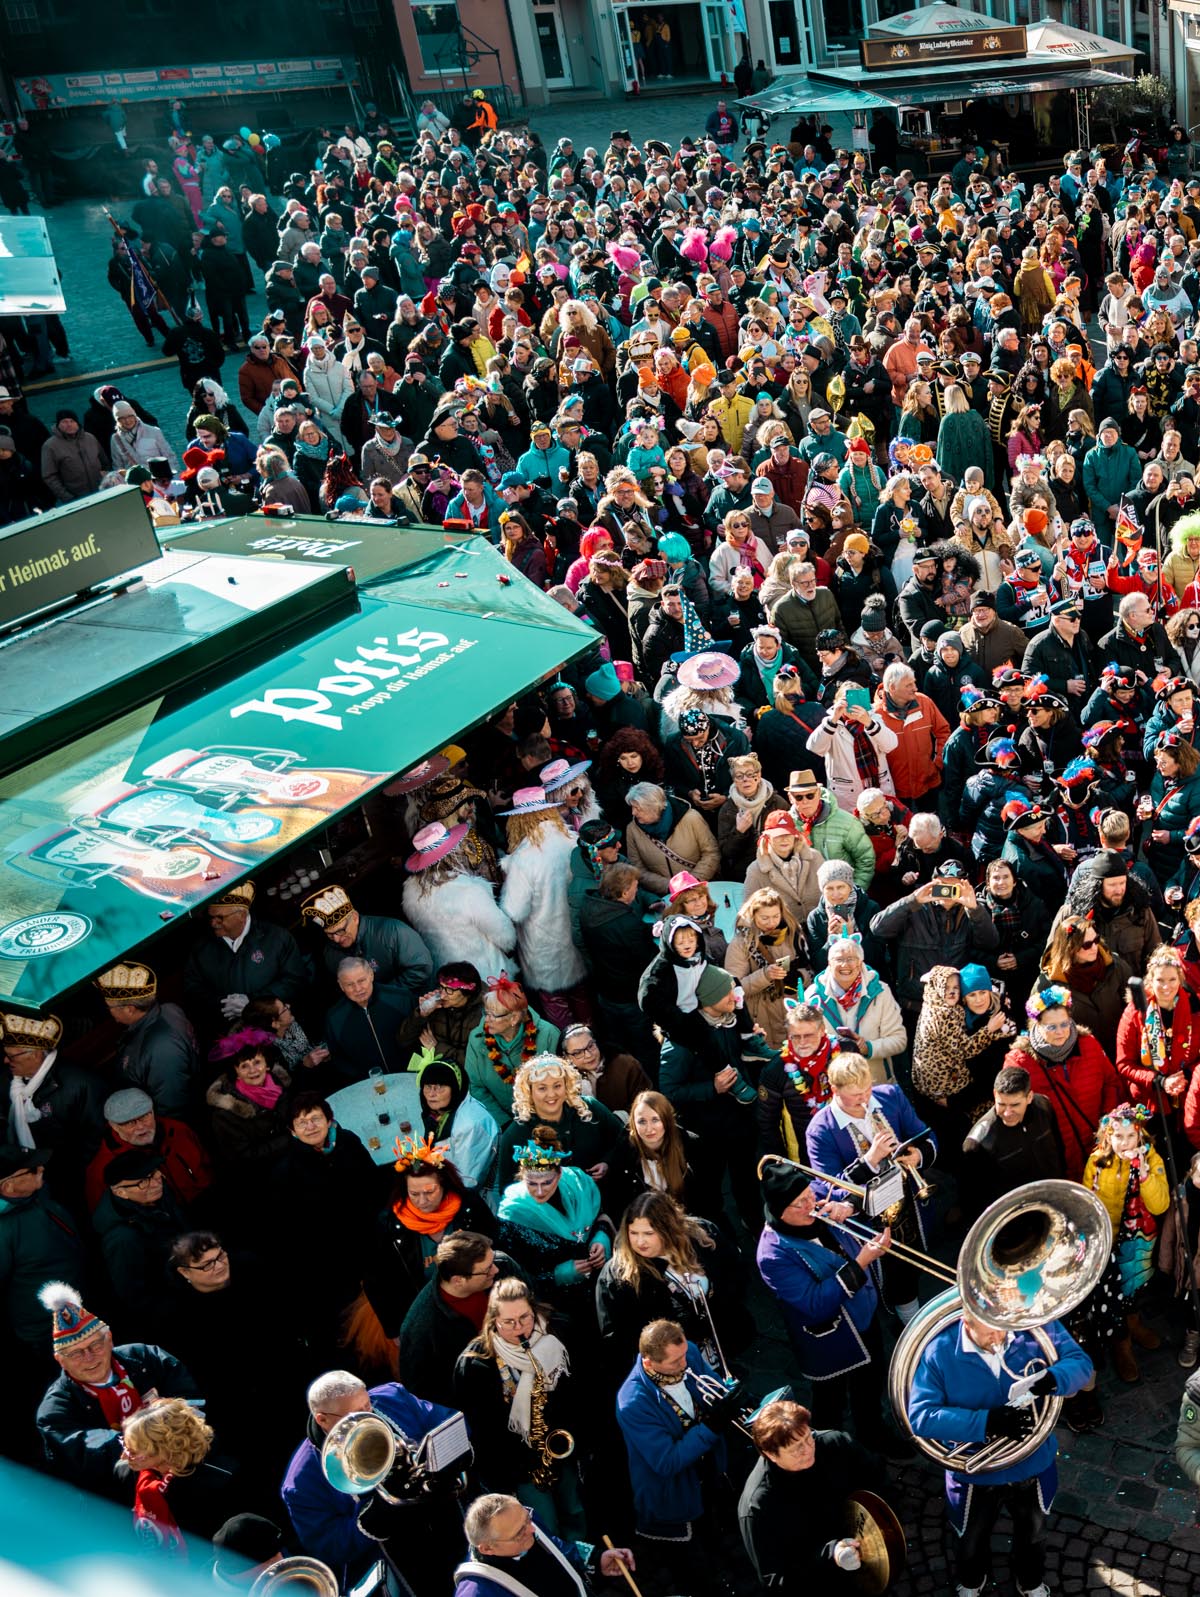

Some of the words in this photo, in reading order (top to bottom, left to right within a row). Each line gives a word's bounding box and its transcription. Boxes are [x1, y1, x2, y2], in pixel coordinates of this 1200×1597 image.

[933, 40, 950, 52] Ludwig
[8, 548, 69, 587] Heimat
[70, 532, 102, 562] auf.
[230, 627, 449, 731] Pott's
[345, 689, 393, 715] Plopp
[386, 676, 411, 694] dir
[403, 652, 455, 681] Heimat
[450, 637, 480, 656] auf.
